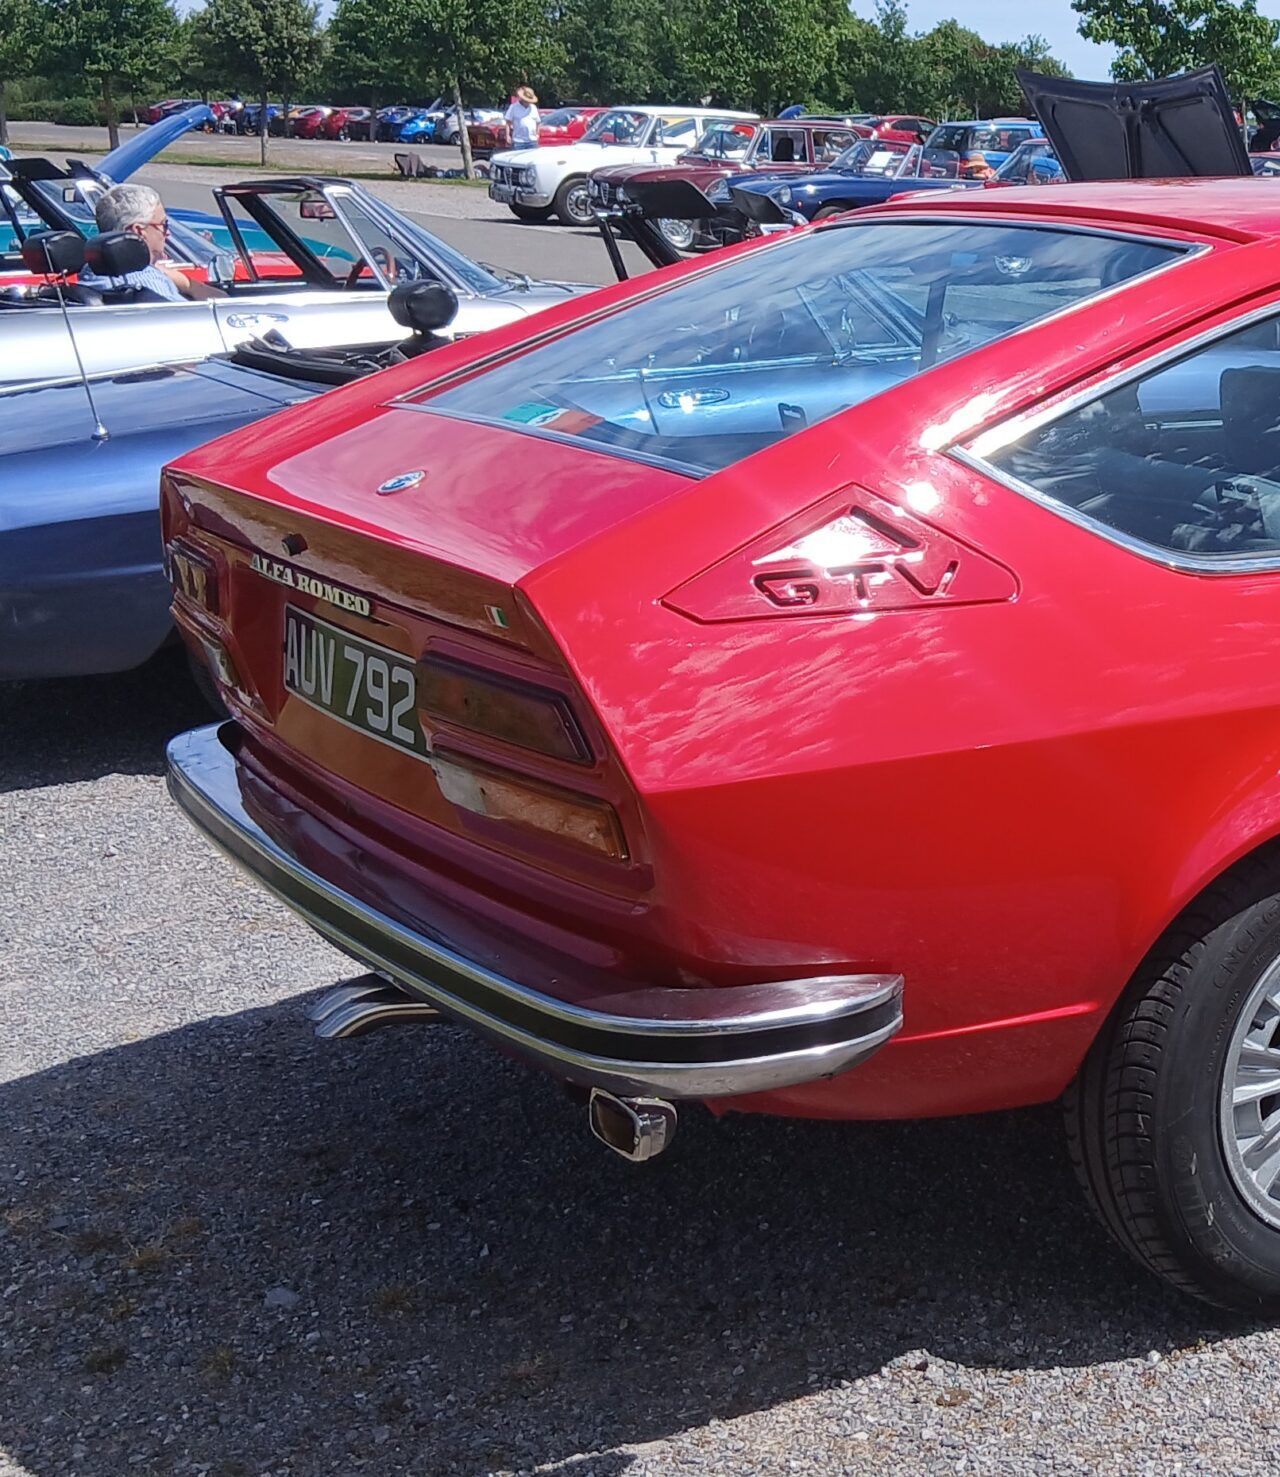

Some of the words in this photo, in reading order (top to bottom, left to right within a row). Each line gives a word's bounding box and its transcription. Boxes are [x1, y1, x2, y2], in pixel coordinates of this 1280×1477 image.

[250, 552, 295, 588] ALFA
[296, 572, 371, 617] ROMEO
[751, 559, 961, 608] GTV
[286, 617, 336, 706] AUV
[344, 644, 416, 745] 792
